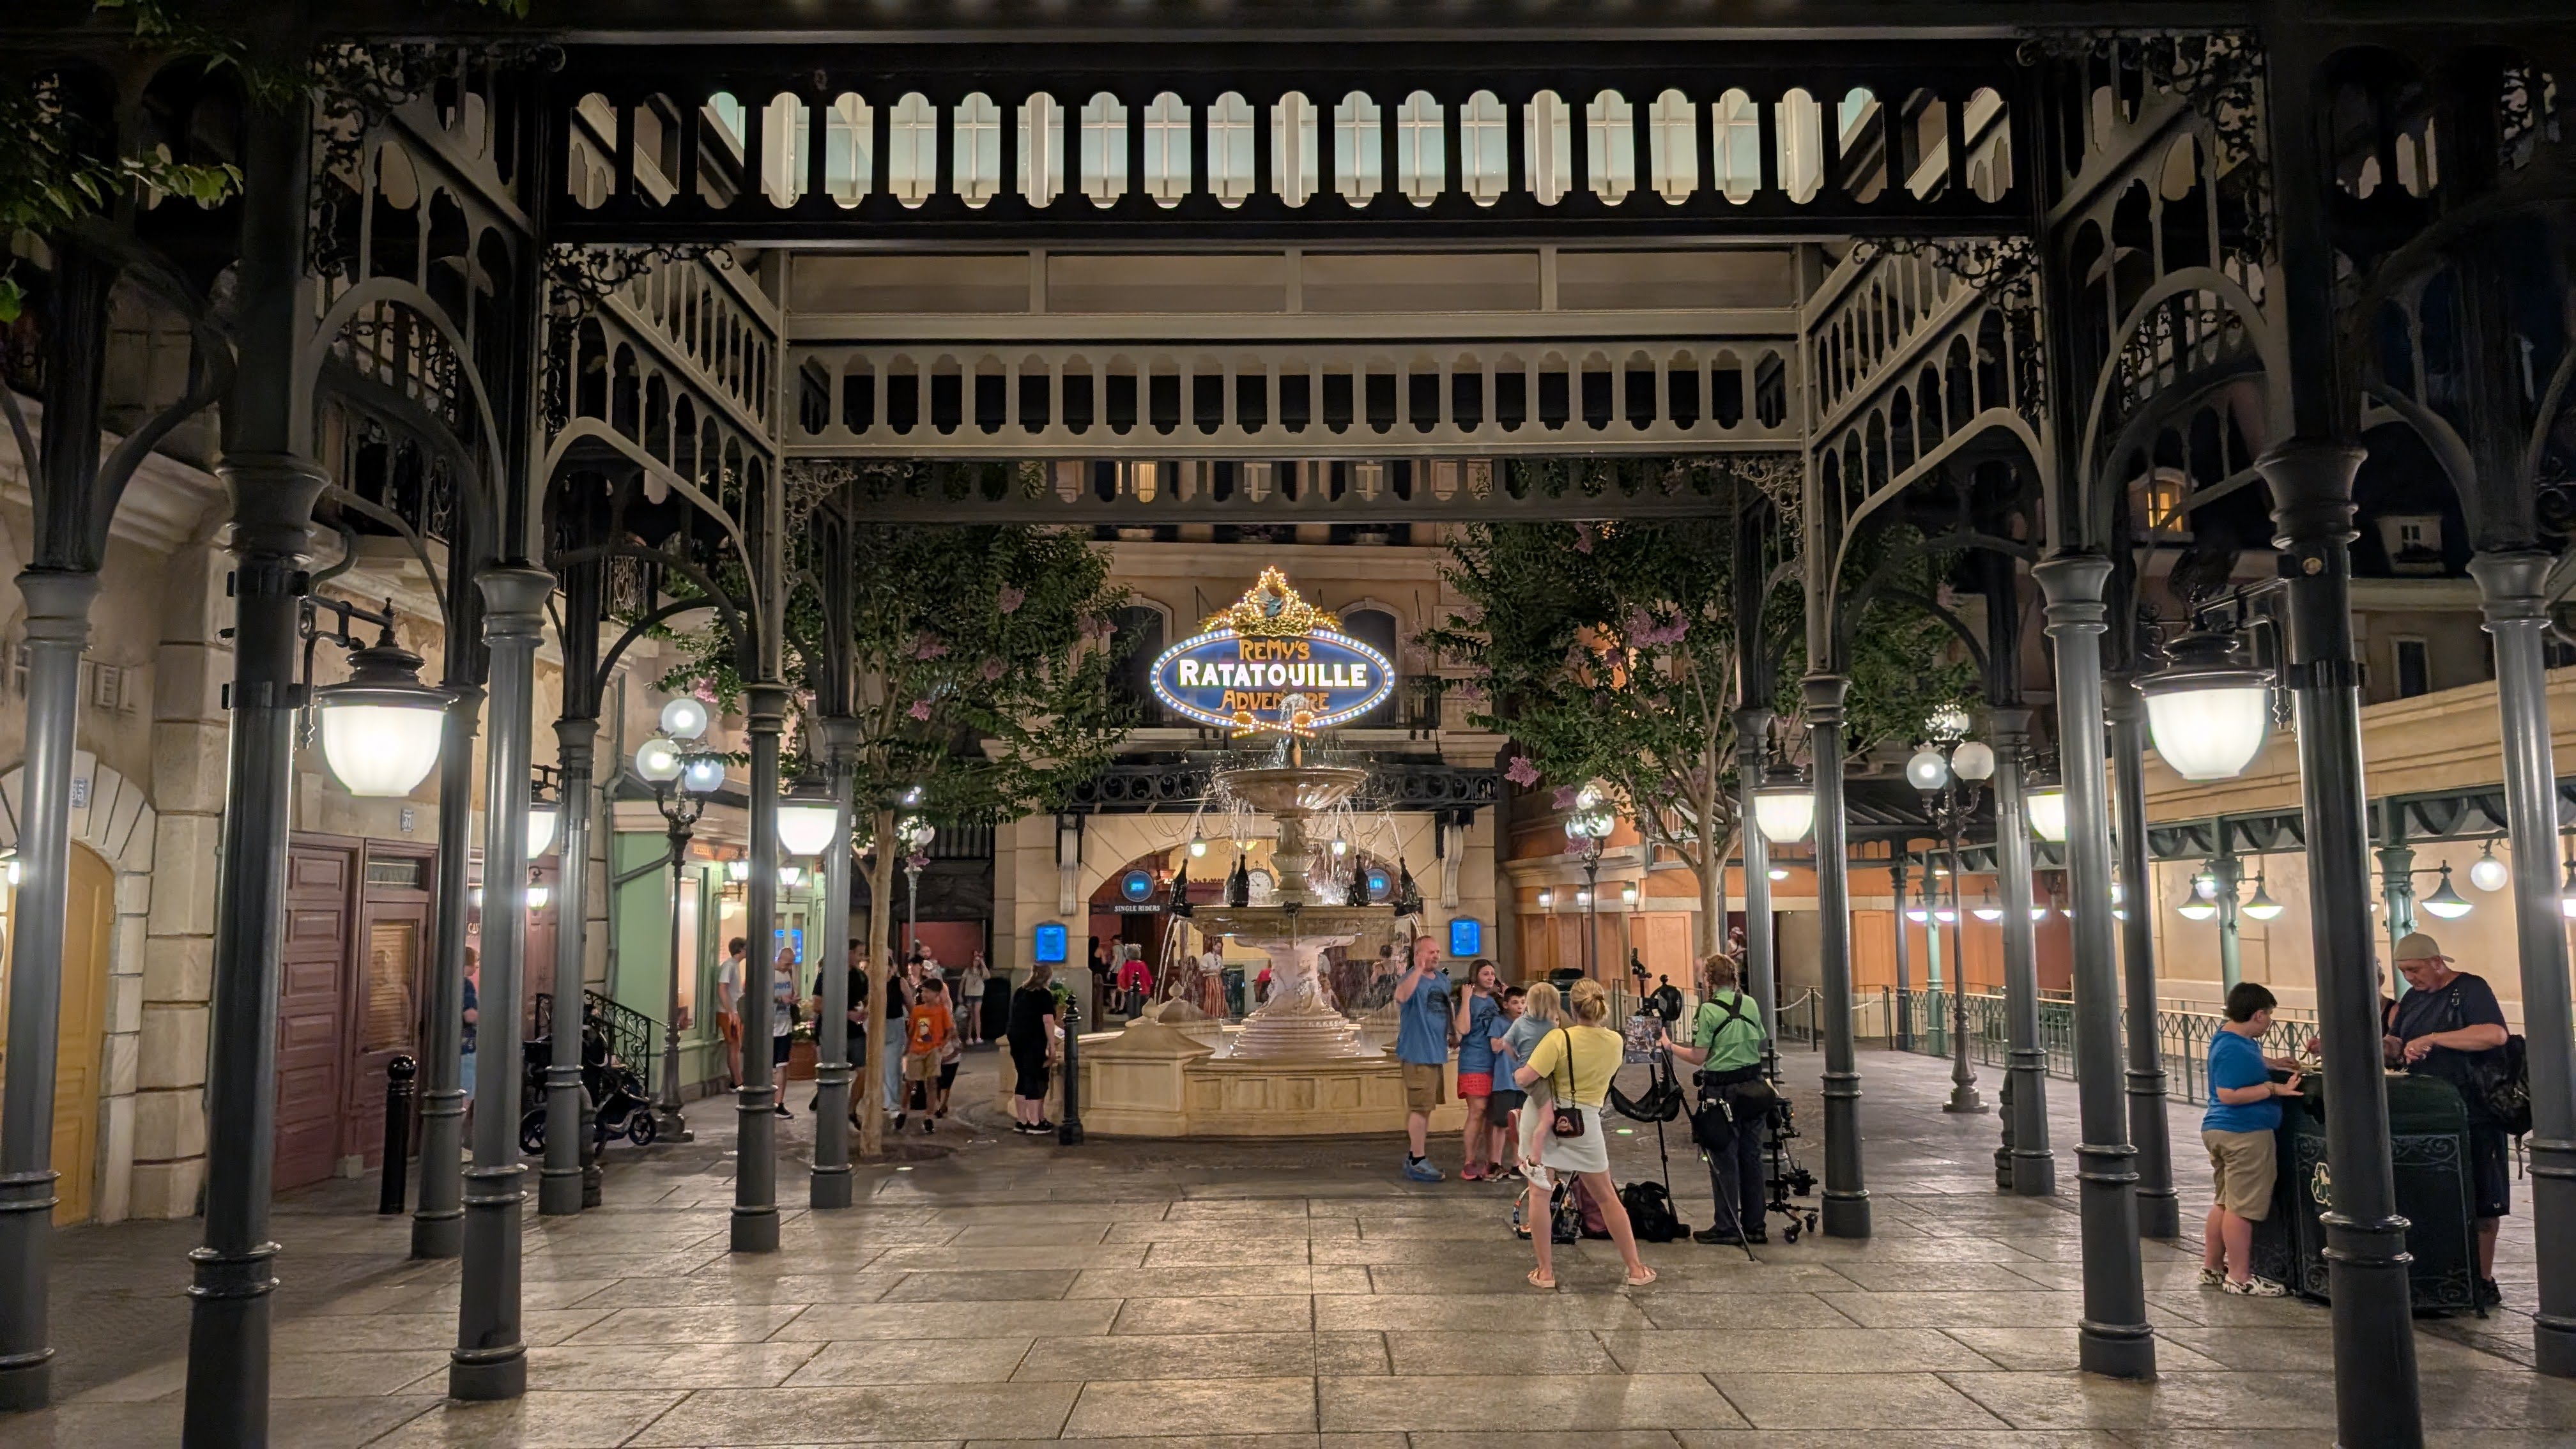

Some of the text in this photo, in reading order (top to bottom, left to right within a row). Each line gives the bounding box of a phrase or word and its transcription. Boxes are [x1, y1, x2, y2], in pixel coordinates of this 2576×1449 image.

[1239, 640, 1310, 662] REMY'S
[1179, 659, 1367, 687] RATATOUILLE
[1216, 689, 1330, 712] ADVENRE
